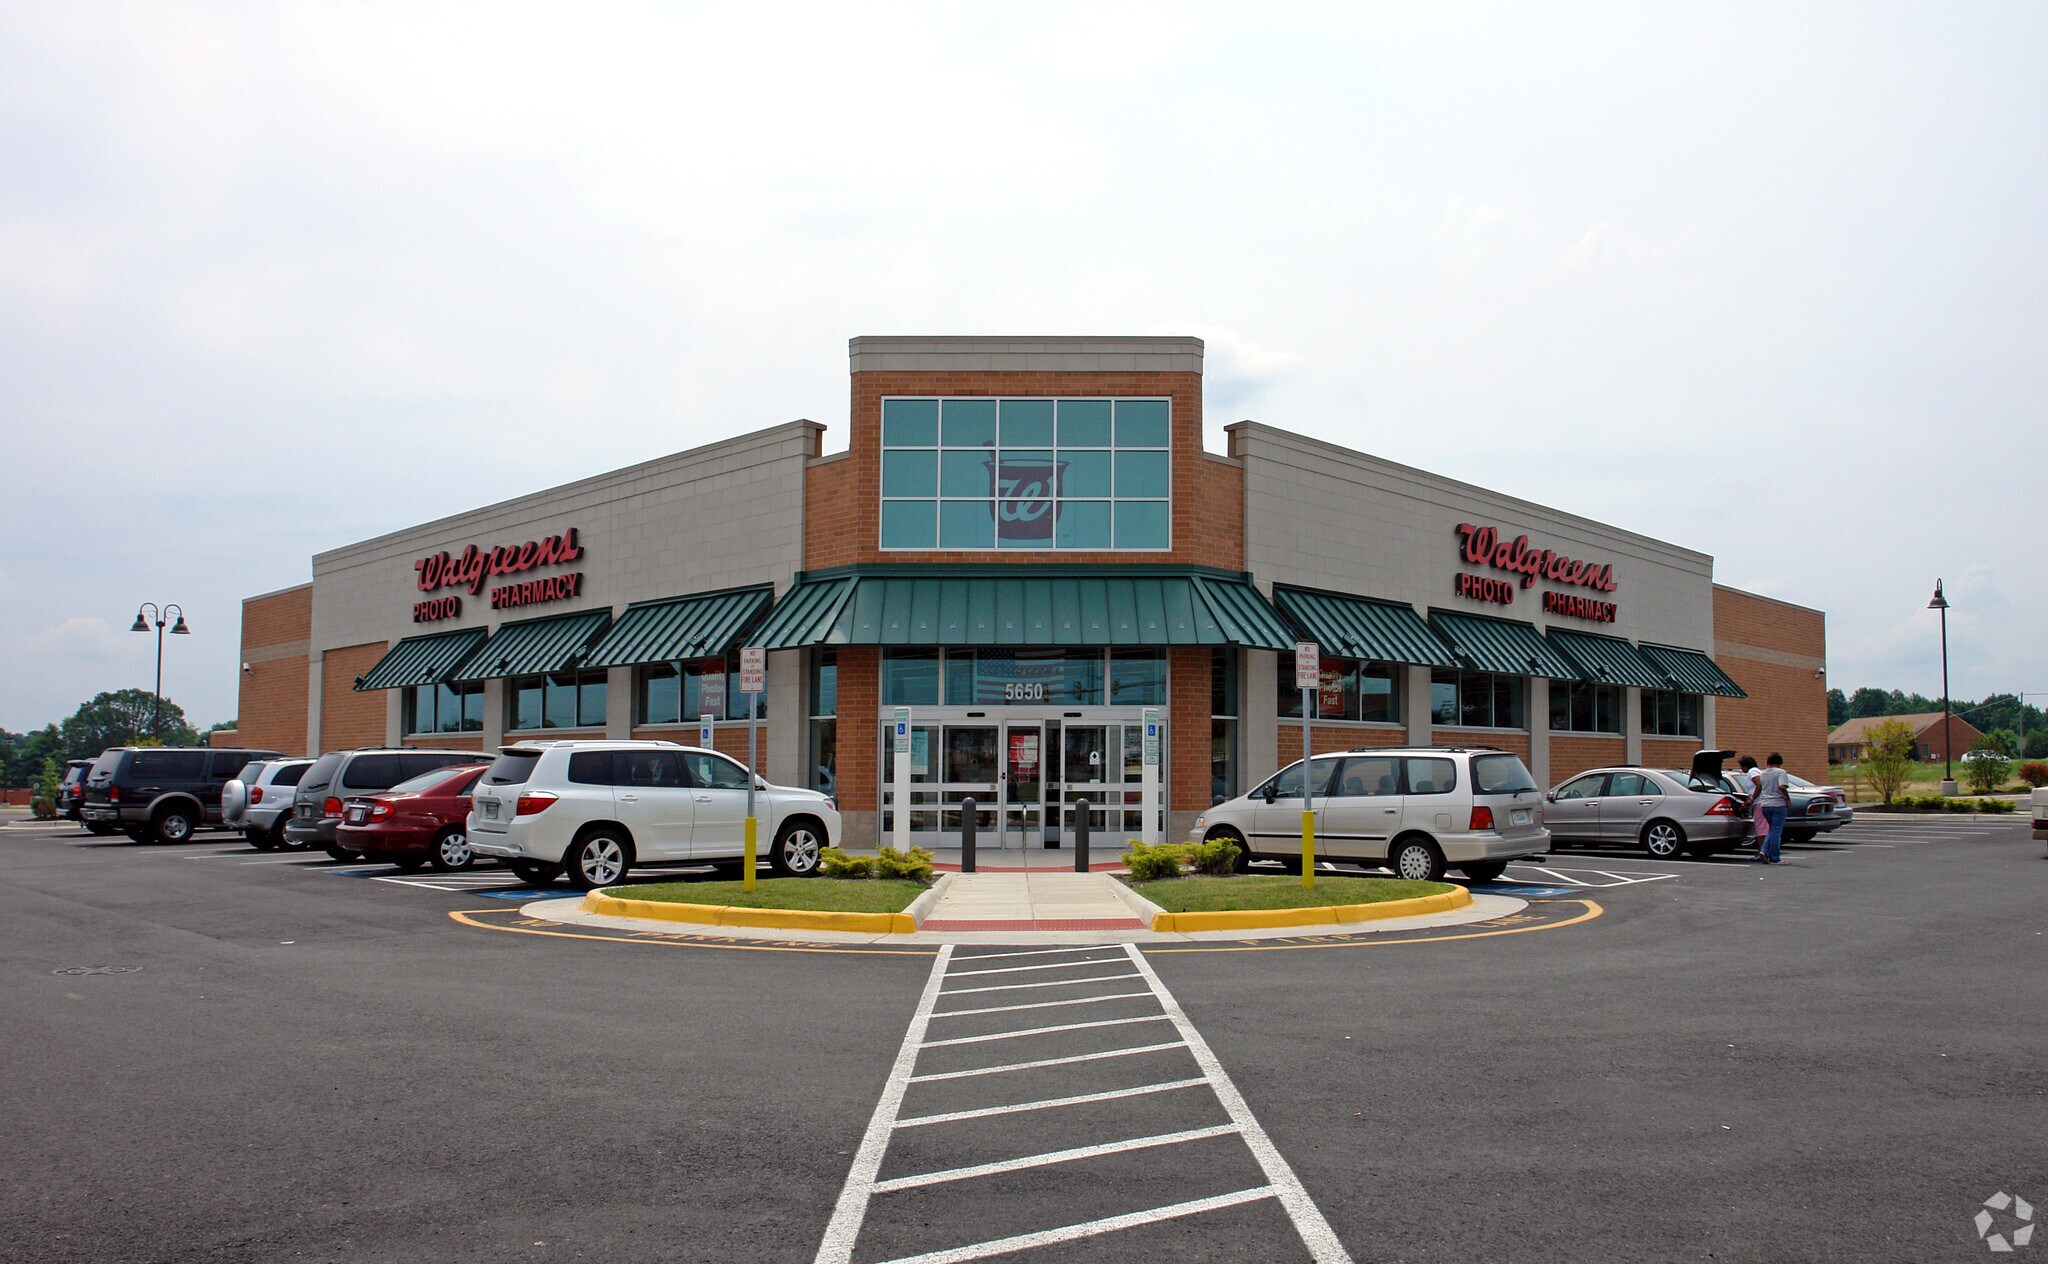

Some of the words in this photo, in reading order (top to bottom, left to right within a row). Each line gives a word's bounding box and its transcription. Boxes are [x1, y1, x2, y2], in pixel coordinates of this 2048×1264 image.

[414, 527, 584, 596] Walgreens
[1455, 522, 1618, 591] Walgreens
[490, 572, 583, 609] PHARMACY
[1457, 572, 1515, 605] PHOTO
[413, 596, 463, 623] PHOTO
[1544, 591, 1618, 623] PHARMACY
[705, 696, 721, 706] Fast
[1005, 683, 1043, 700] 5650
[1323, 694, 1338, 705] Fast
[627, 931, 840, 948] PARKING
[1238, 933, 1366, 946] FIRE
